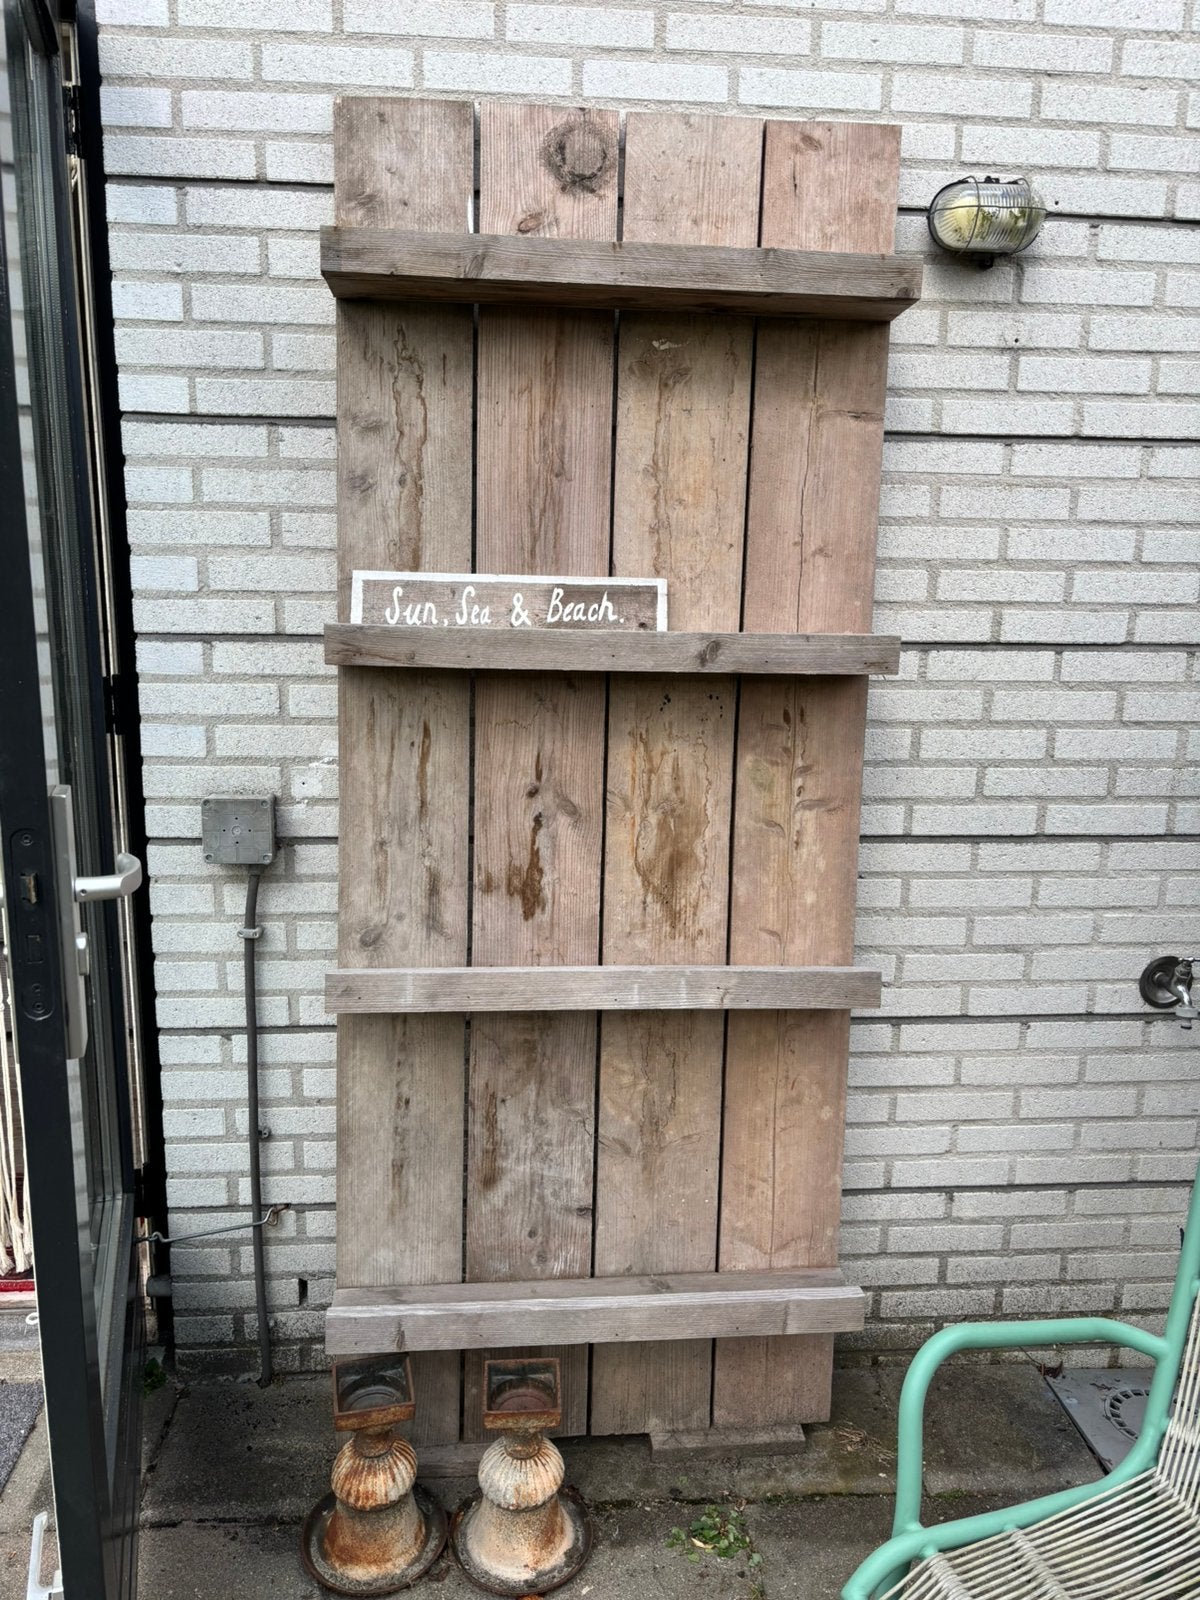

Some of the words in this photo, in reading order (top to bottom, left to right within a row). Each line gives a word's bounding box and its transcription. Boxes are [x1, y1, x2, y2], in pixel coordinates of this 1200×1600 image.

[385, 586, 449, 627] Sun,
[456, 585, 492, 625] Sea
[511, 593, 531, 627] &
[546, 588, 625, 624] Beach.
